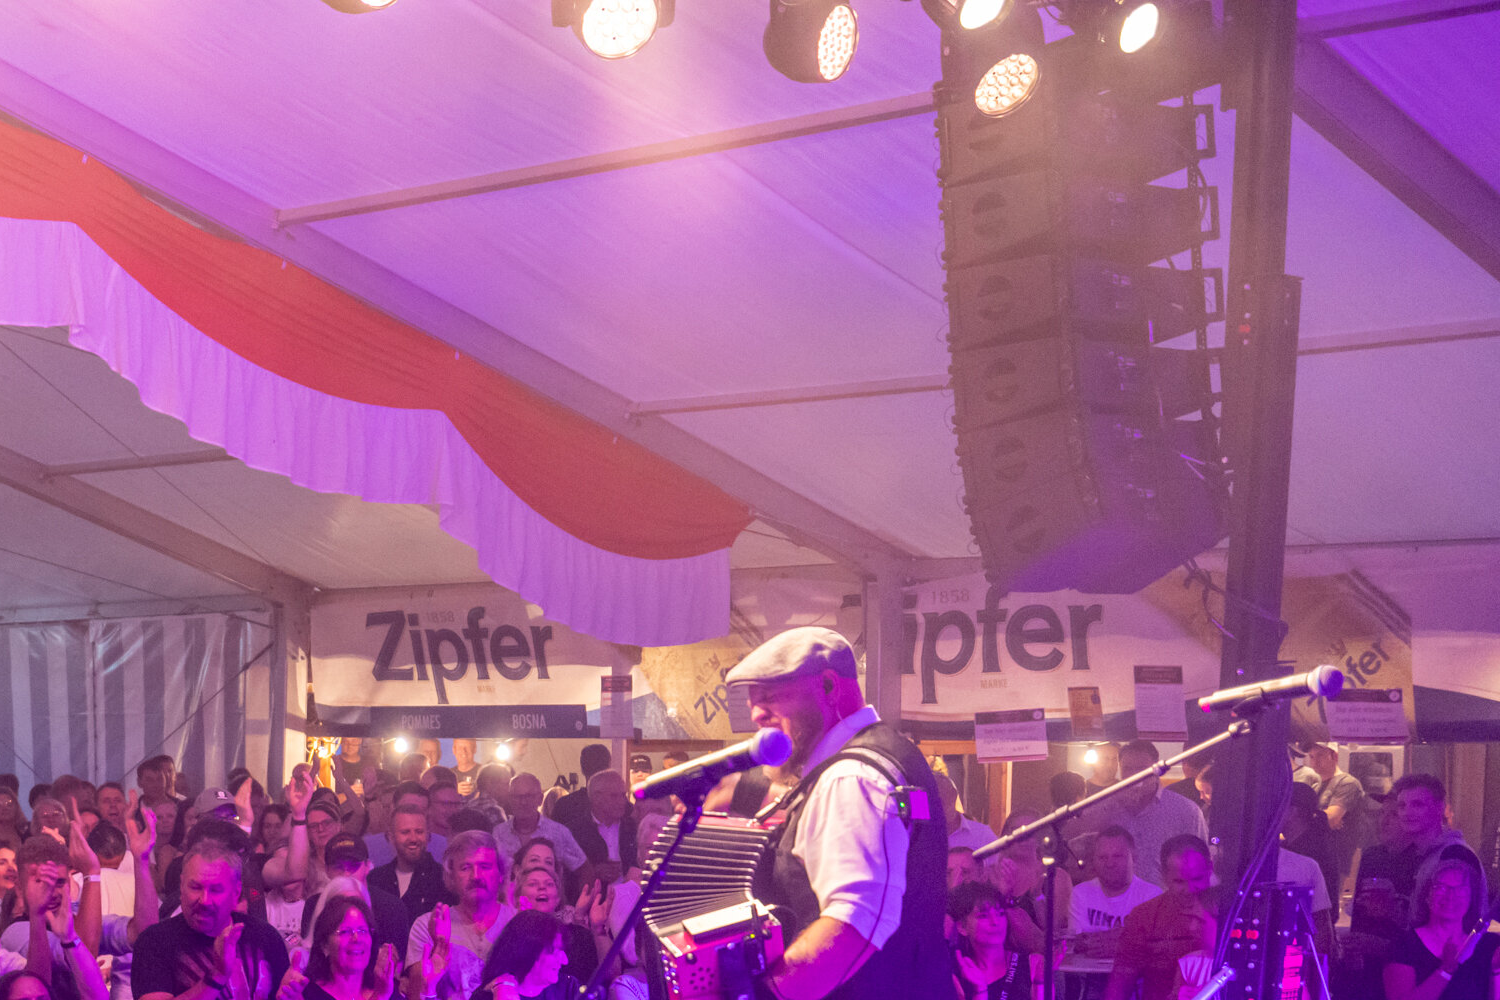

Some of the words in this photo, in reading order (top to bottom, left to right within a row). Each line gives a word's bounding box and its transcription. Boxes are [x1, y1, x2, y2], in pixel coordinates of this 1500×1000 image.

[366, 606, 553, 705] Zipfer
[401, 714, 441, 730] POMMES
[512, 713, 547, 729] BOSNA
